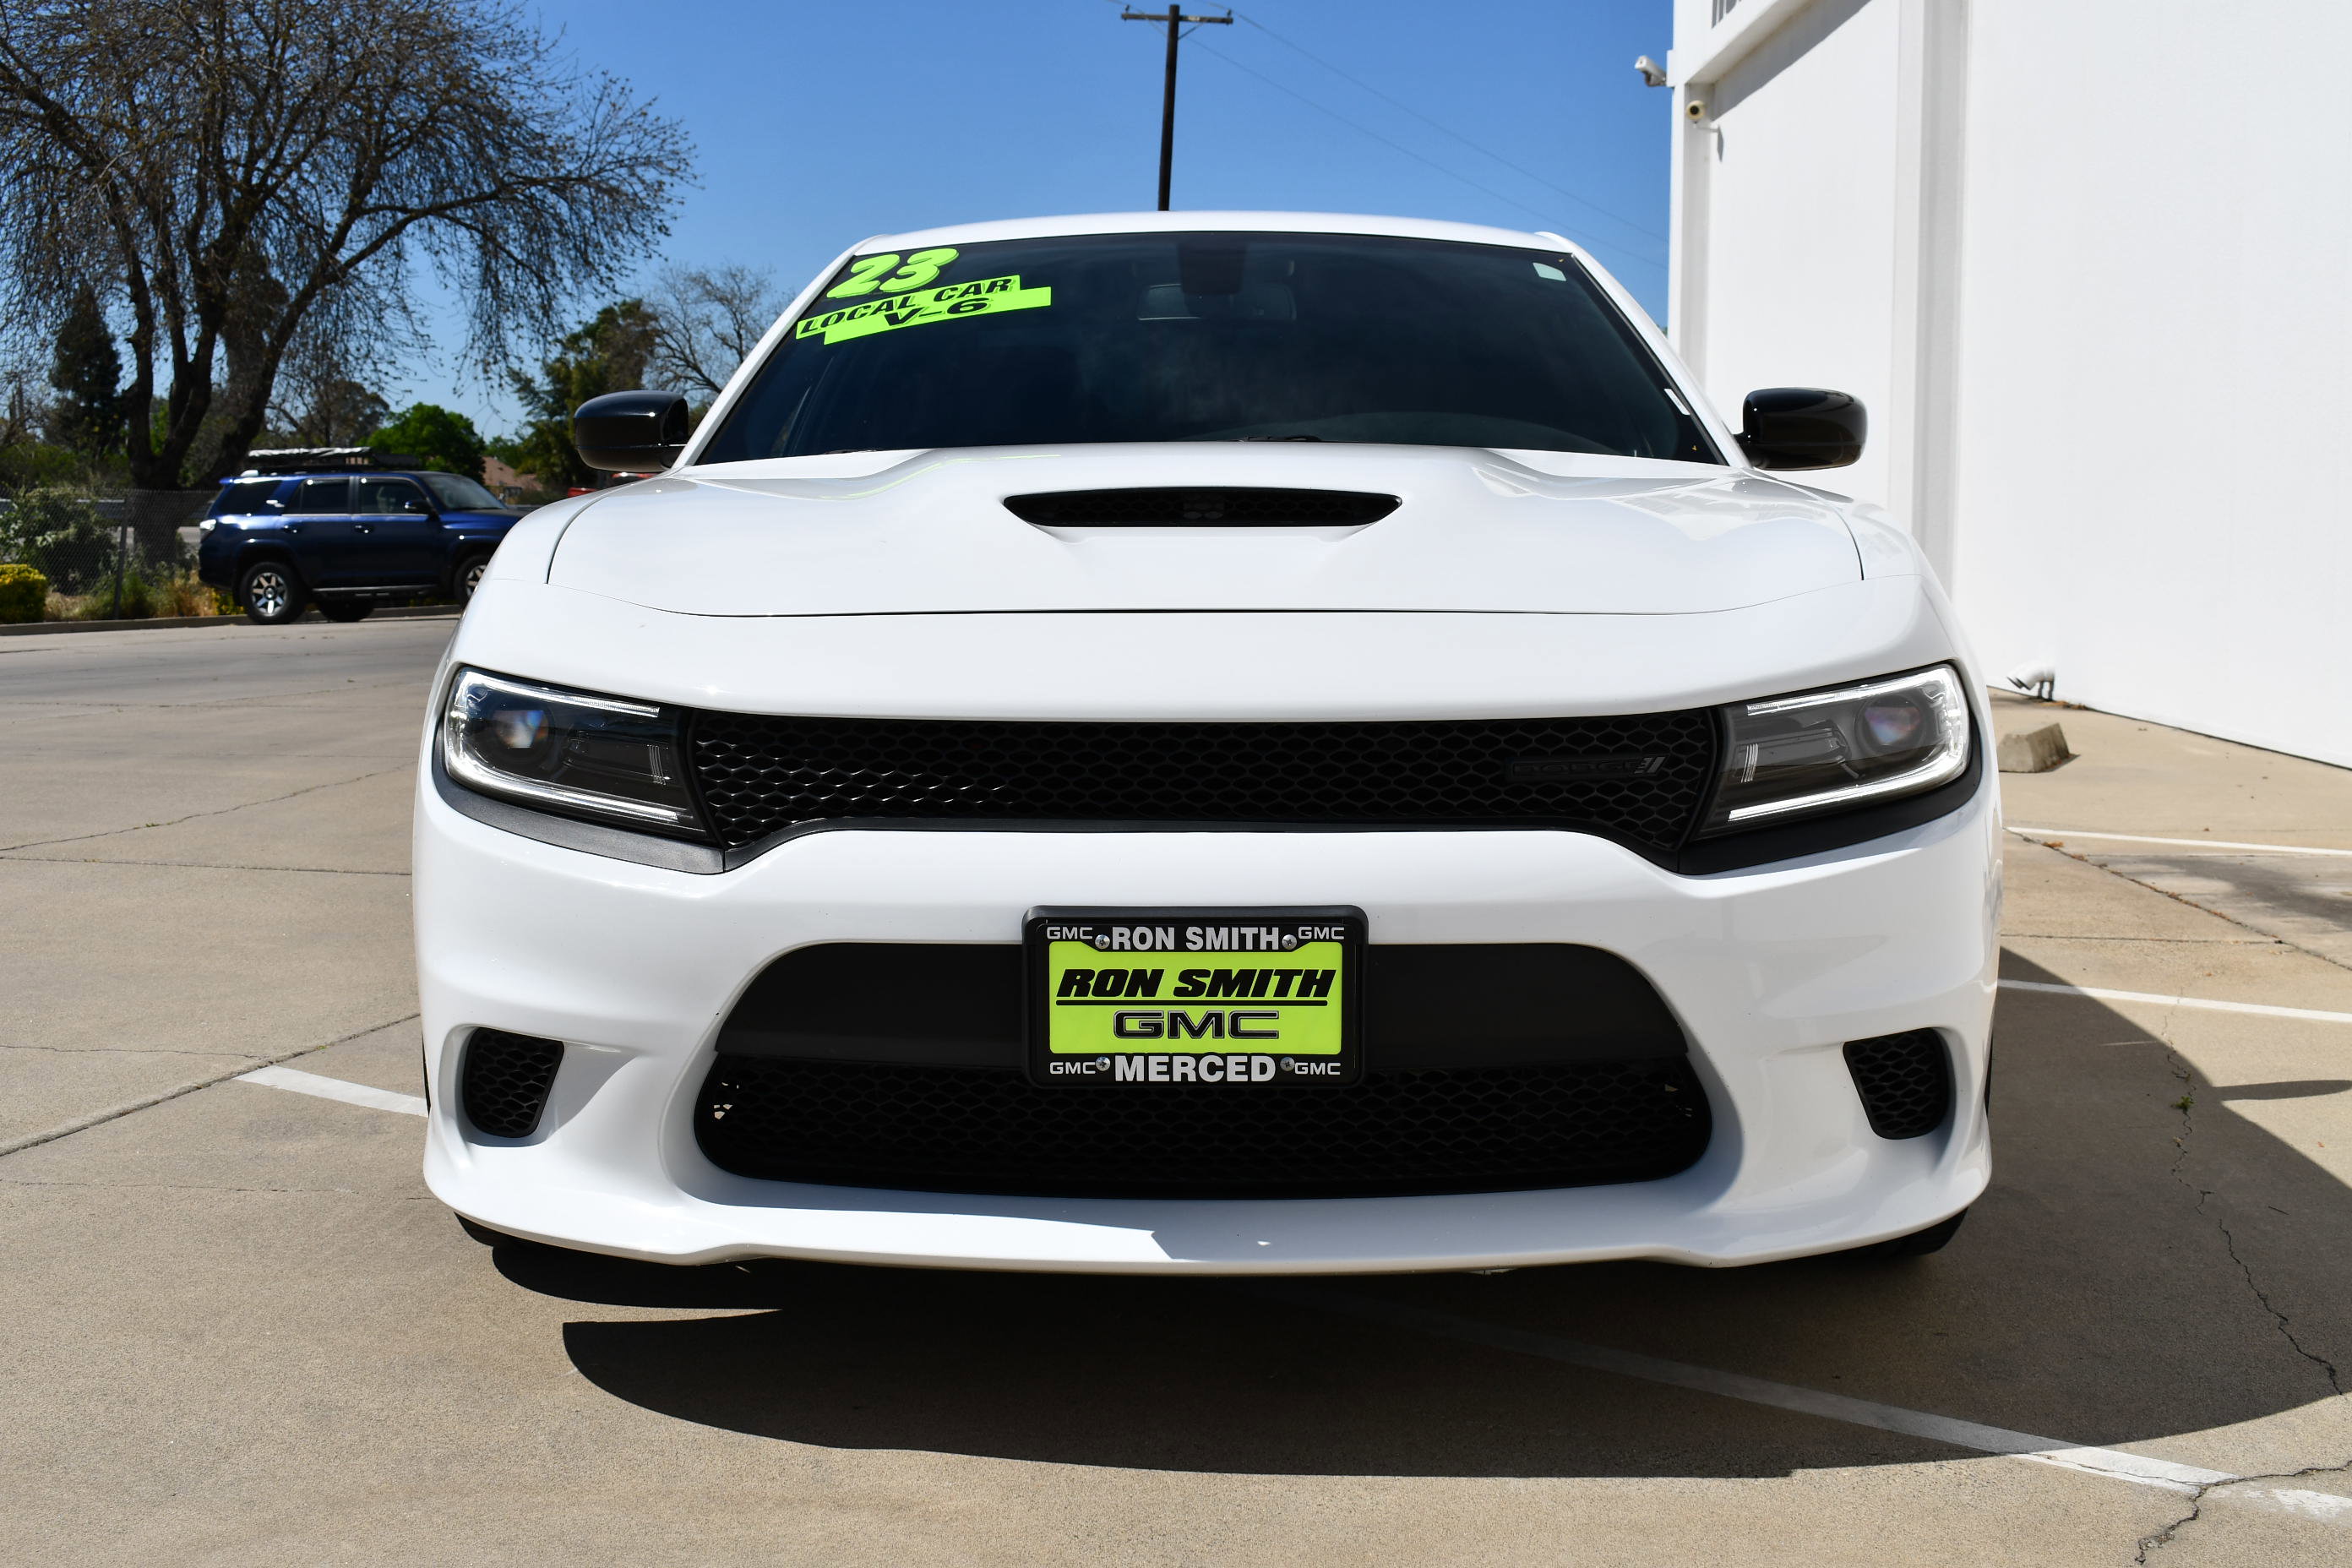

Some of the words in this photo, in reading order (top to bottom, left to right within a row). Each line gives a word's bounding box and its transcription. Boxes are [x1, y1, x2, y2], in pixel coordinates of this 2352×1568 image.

[826, 248, 959, 298] 23
[799, 296, 917, 335] LOCAL
[933, 278, 1012, 302] CAR
[884, 298, 989, 326] V-6
[1047, 927, 1092, 939] GMC
[1112, 927, 1174, 950] RON
[1185, 927, 1279, 950] SMITH
[1298, 927, 1344, 939] GMC
[1056, 968, 1164, 998] RON
[1173, 968, 1337, 998] SMITH
[1113, 1010, 1279, 1038] GMC
[1049, 1062, 1096, 1074] GMC
[1114, 1055, 1276, 1082] MERCED
[1294, 1062, 1341, 1075] GMC
